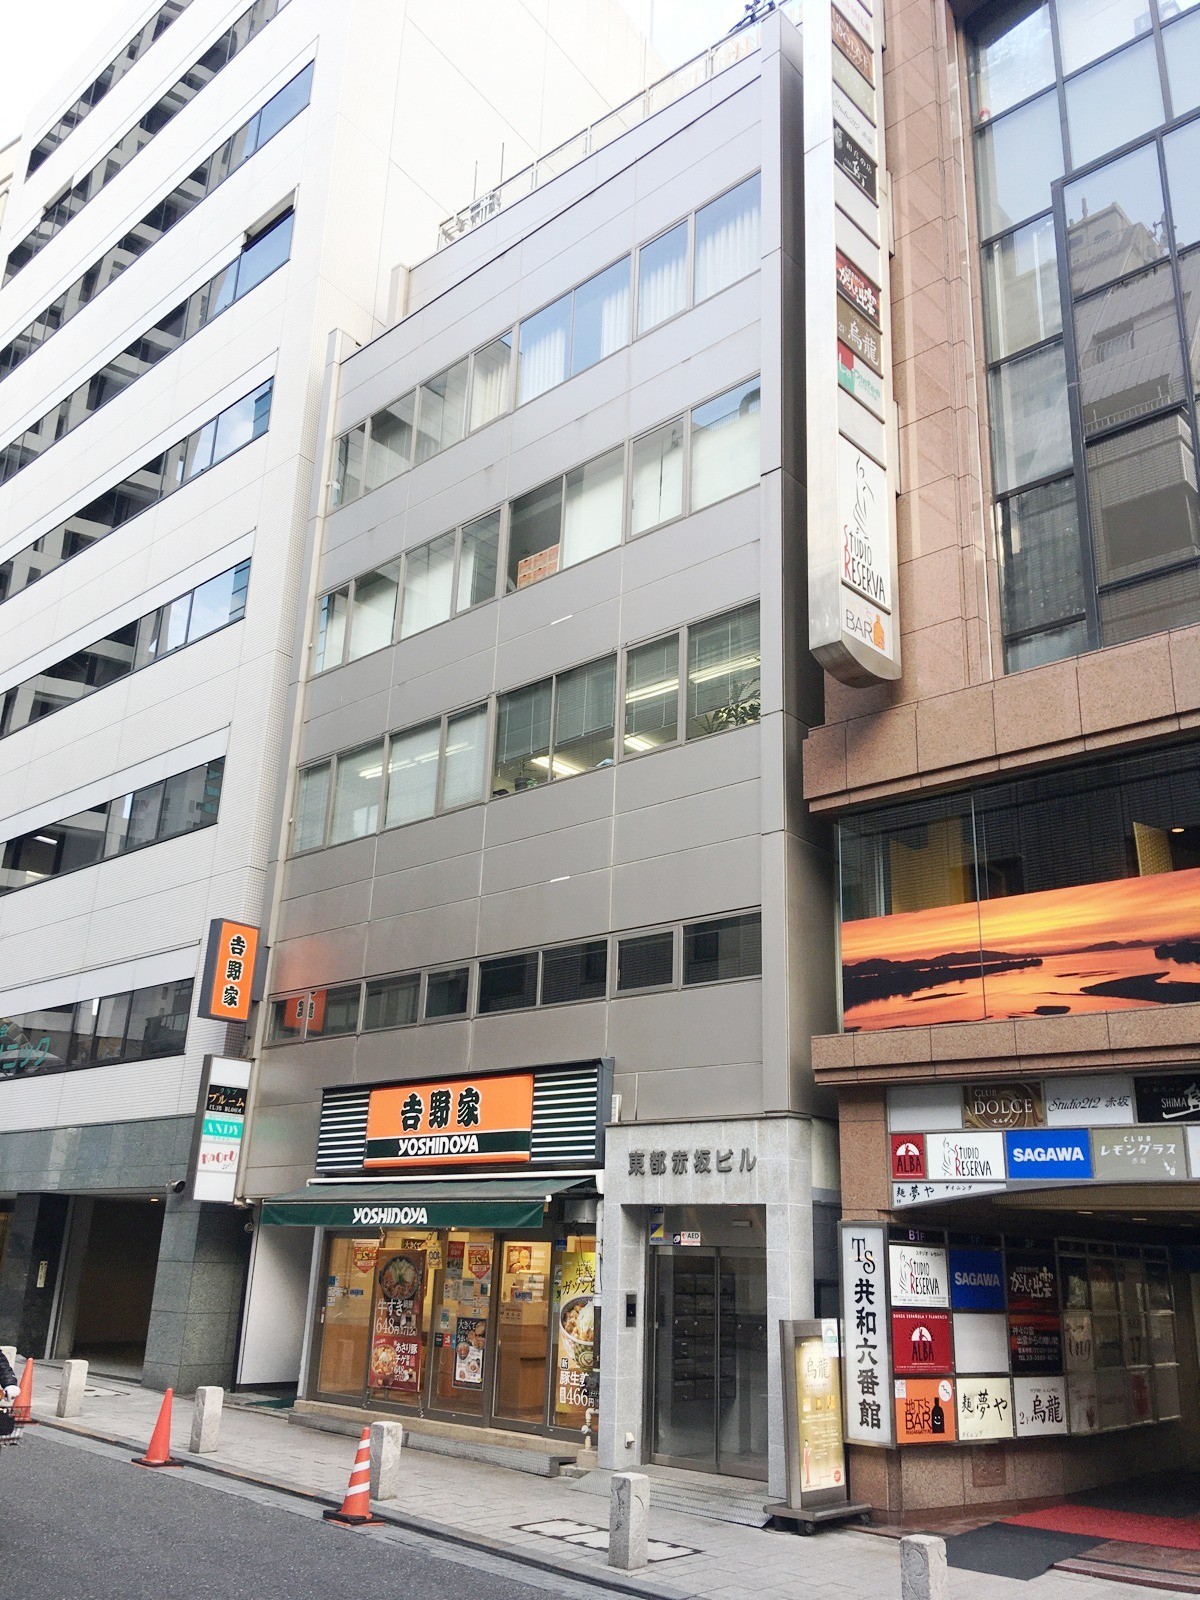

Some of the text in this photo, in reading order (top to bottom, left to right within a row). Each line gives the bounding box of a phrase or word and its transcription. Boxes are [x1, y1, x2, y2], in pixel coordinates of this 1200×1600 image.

[844, 523, 873, 567] STUDIO
[844, 551, 886, 604] RESERVA
[845, 608, 874, 644] BAR
[222, 935, 247, 1008] 吉野家
[208, 1092, 245, 1108] ブルーム
[400, 1086, 480, 1132] 吉野家
[974, 1098, 1033, 1115] DOLCE
[1104, 1095, 1131, 1108] 赤坂
[1161, 1097, 1188, 1109] SHIMA
[204, 1123, 242, 1136] ANDY
[1123, 1135, 1152, 1143] CLUB
[398, 1134, 479, 1156] YOSHINOYA
[954, 1144, 979, 1160] STUDIO
[1013, 1147, 1084, 1162] SAGAWA
[1100, 1143, 1176, 1156] レモングラス
[628, 1147, 757, 1176] 東都赤坂ビル
[896, 1155, 922, 1173] ALBA
[955, 1158, 992, 1177] RESERVA
[352, 1206, 428, 1225] YOSHINOYA
[910, 1258, 930, 1277] STUDIO
[910, 1275, 940, 1296] RESERVA
[954, 1271, 1001, 1287] SAGAWA
[854, 1278, 882, 1430] 共和六番館
[912, 1340, 935, 1362] ALBA
[906, 1411, 932, 1430] BAR
